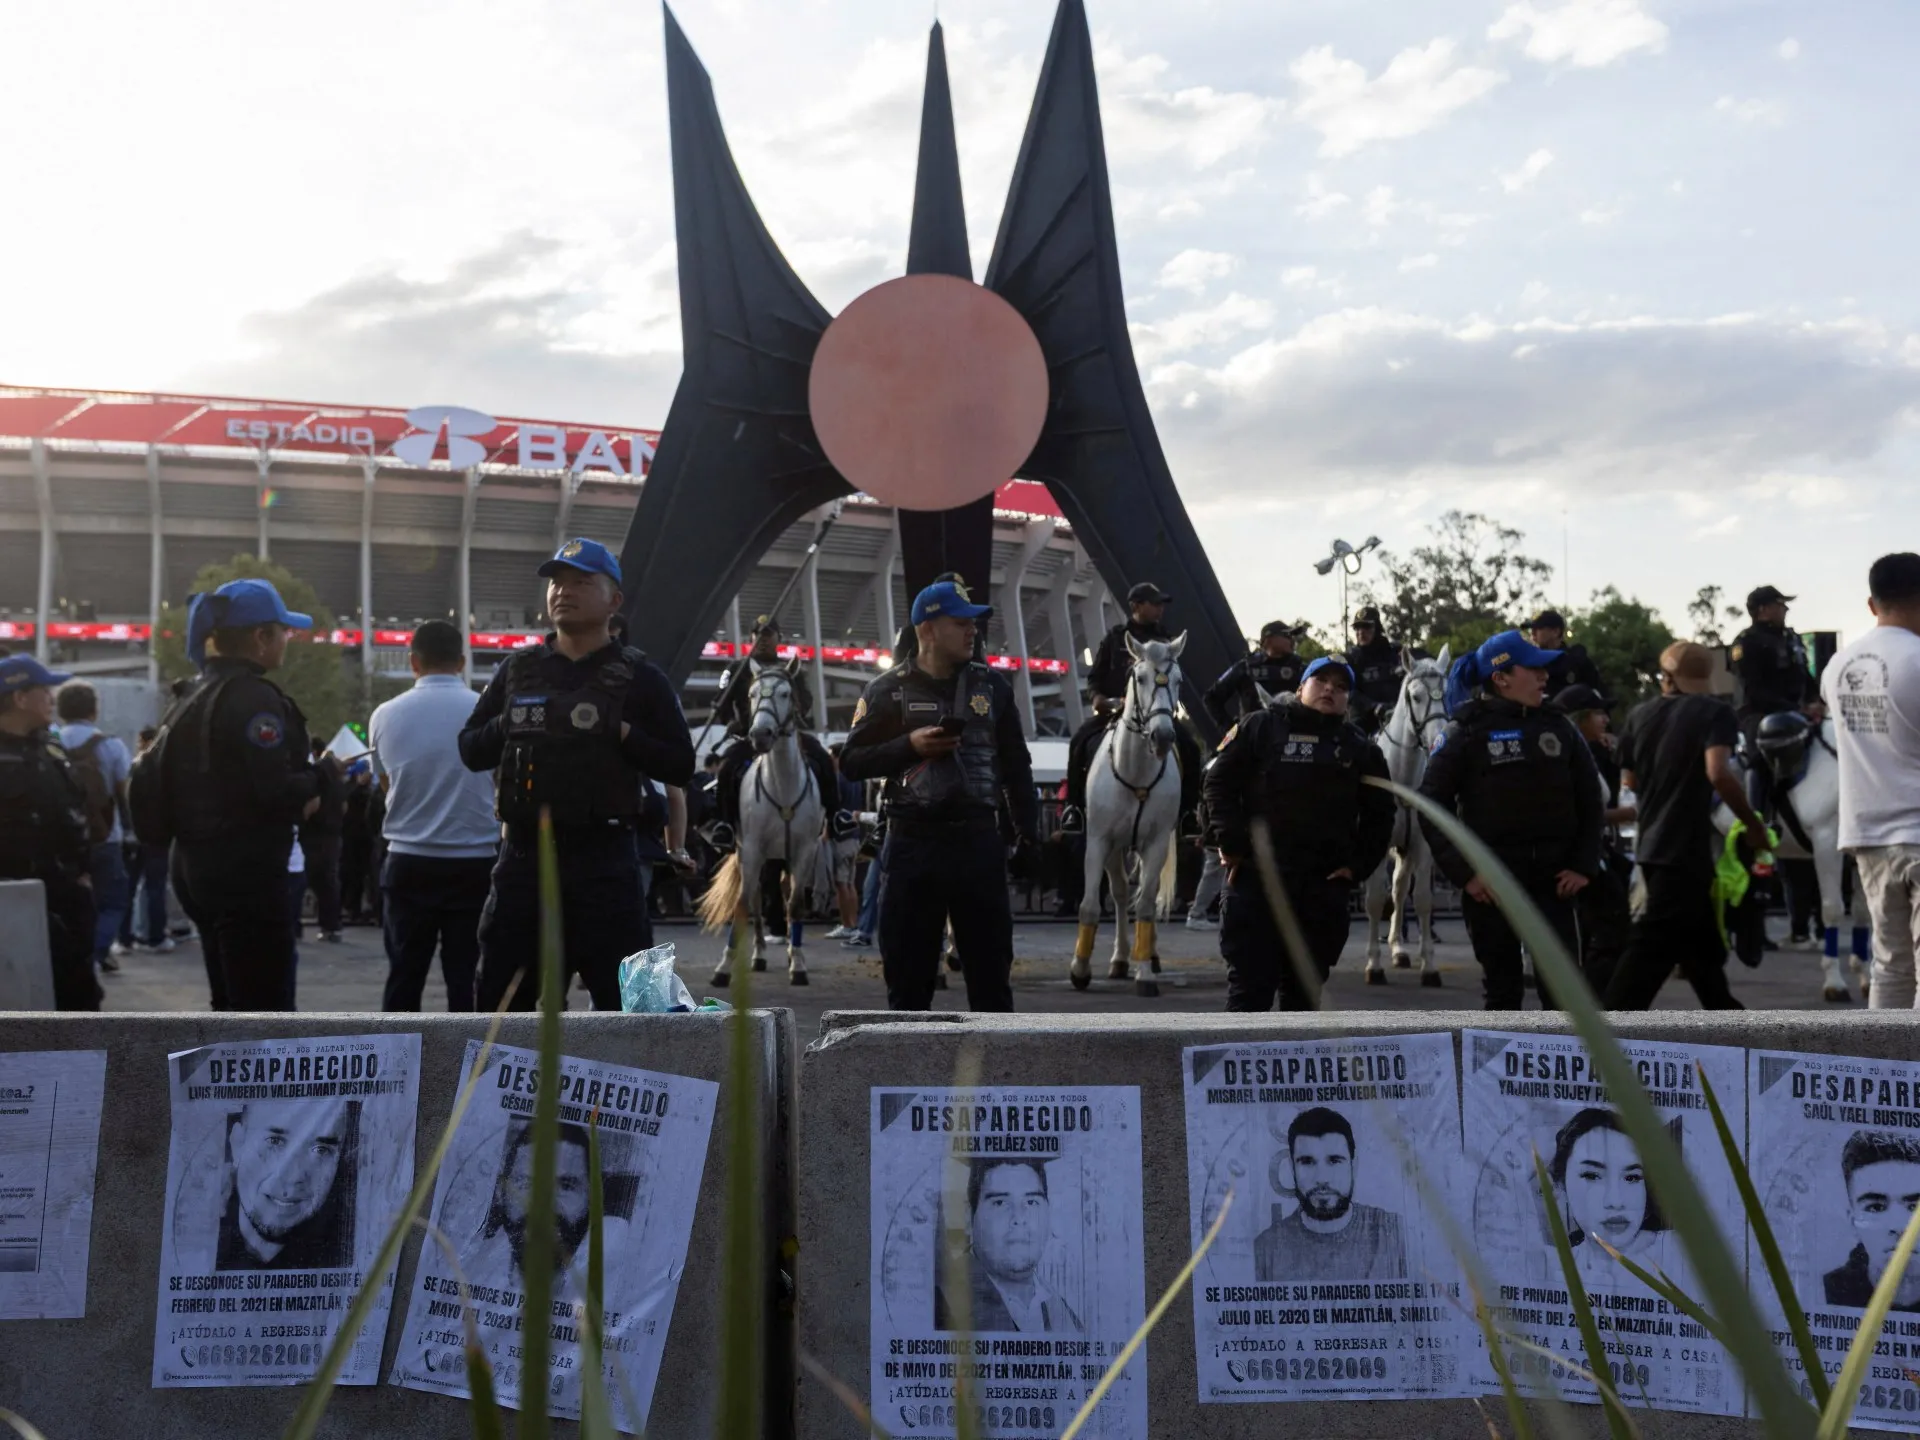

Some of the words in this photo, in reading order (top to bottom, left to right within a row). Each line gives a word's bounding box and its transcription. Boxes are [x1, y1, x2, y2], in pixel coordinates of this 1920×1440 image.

[225, 418, 375, 447] ESTADIO
[209, 1053, 379, 1084] DESAPARECIDO
[1223, 1054, 1407, 1085] DESAPARECIDO
[1505, 1051, 1694, 1089] DESAPACIDA
[189, 1086, 211, 1100] LUIS
[213, 1084, 268, 1099] HUMBERTO
[271, 1081, 336, 1098] VALDELAMAR
[339, 1079, 405, 1096] BUSTAMANTE
[497, 1063, 670, 1118] DESPARECIDO
[923, 1095, 938, 1103] NOS
[1002, 1095, 1018, 1103] NOS
[1060, 1095, 1087, 1103] TODOS
[1207, 1088, 1256, 1104] MISRAEL
[1258, 1086, 1313, 1103] ARMANDO
[1316, 1083, 1377, 1102] SEPÚLVEDA
[1498, 1079, 1549, 1099] YAJAIRA
[1553, 1081, 1591, 1102] SUJEY
[1792, 1071, 1920, 1108] DESAPARE
[500, 1093, 534, 1113] CÉSAR
[1803, 1101, 1835, 1121] SAÚL
[1839, 1105, 1870, 1124] YAEL
[585, 1109, 633, 1132] BRTOLDI
[633, 1117, 661, 1137] PÁEZ
[911, 1105, 1092, 1132] DESAPARECIDO
[952, 1136, 980, 1152] ALEX
[984, 1133, 1025, 1152] PELÁEZ
[1029, 1136, 1059, 1152] SOTO
[169, 1276, 182, 1291] SE
[185, 1275, 245, 1291] DESCONOCE
[247, 1274, 261, 1289] SU
[263, 1273, 317, 1289] PARADERO
[423, 1275, 438, 1292] SE
[500, 1291, 517, 1307] SU
[1205, 1287, 1221, 1303] SE
[1223, 1286, 1289, 1302] DESCONOCE
[1292, 1285, 1308, 1302] SU
[1311, 1284, 1370, 1301] PARADERO
[1374, 1284, 1411, 1300] DESDE
[1500, 1285, 1519, 1301] FUE
[1522, 1287, 1568, 1306] PRIVADA
[1588, 1293, 1602, 1308] SU
[1605, 1295, 1654, 1313] LIBERTAD
[1657, 1300, 1669, 1314] EL
[171, 1297, 216, 1314] FEBRERO
[219, 1296, 237, 1312] DEL
[241, 1297, 266, 1312] 2021
[268, 1296, 283, 1312] EN
[428, 1299, 461, 1320] MAYO
[483, 1311, 513, 1330] 2023
[1218, 1309, 1252, 1326] JULIO
[1254, 1309, 1275, 1325] DEL
[1278, 1308, 1310, 1324] 2020
[1313, 1308, 1328, 1324] EN
[1330, 1304, 1396, 1325] MAZATLÁN,
[1545, 1311, 1565, 1327] DEL
[1615, 1318, 1677, 1339] MAZATLÁN,
[1881, 1319, 1896, 1335] SU
[171, 1324, 236, 1344] ¡AYÚDALO
[244, 1327, 252, 1338] A
[261, 1325, 328, 1338] REGRESAR
[491, 1342, 499, 1354] A
[890, 1339, 904, 1355] SE
[975, 1339, 990, 1356] SU
[993, 1339, 1050, 1356] PARADERO
[1055, 1340, 1090, 1357] DESDE
[1215, 1336, 1286, 1357] ¡AYÚDALO
[1295, 1340, 1305, 1351] A
[1314, 1338, 1387, 1351] REGRESAR
[1396, 1339, 1405, 1350] A
[1560, 1338, 1570, 1350] A
[1662, 1347, 1672, 1360] A
[1893, 1342, 1907, 1358] EN
[885, 1362, 900, 1378] DE
[903, 1362, 936, 1378] MAYO
[995, 1363, 1009, 1379] EN
[1012, 1360, 1076, 1381] MAZATLÁN,
[1247, 1356, 1387, 1381] 6693262089
[985, 1386, 1058, 1401] REGRESAR
[1066, 1387, 1076, 1401] A
[919, 1404, 1056, 1430] 669262089
